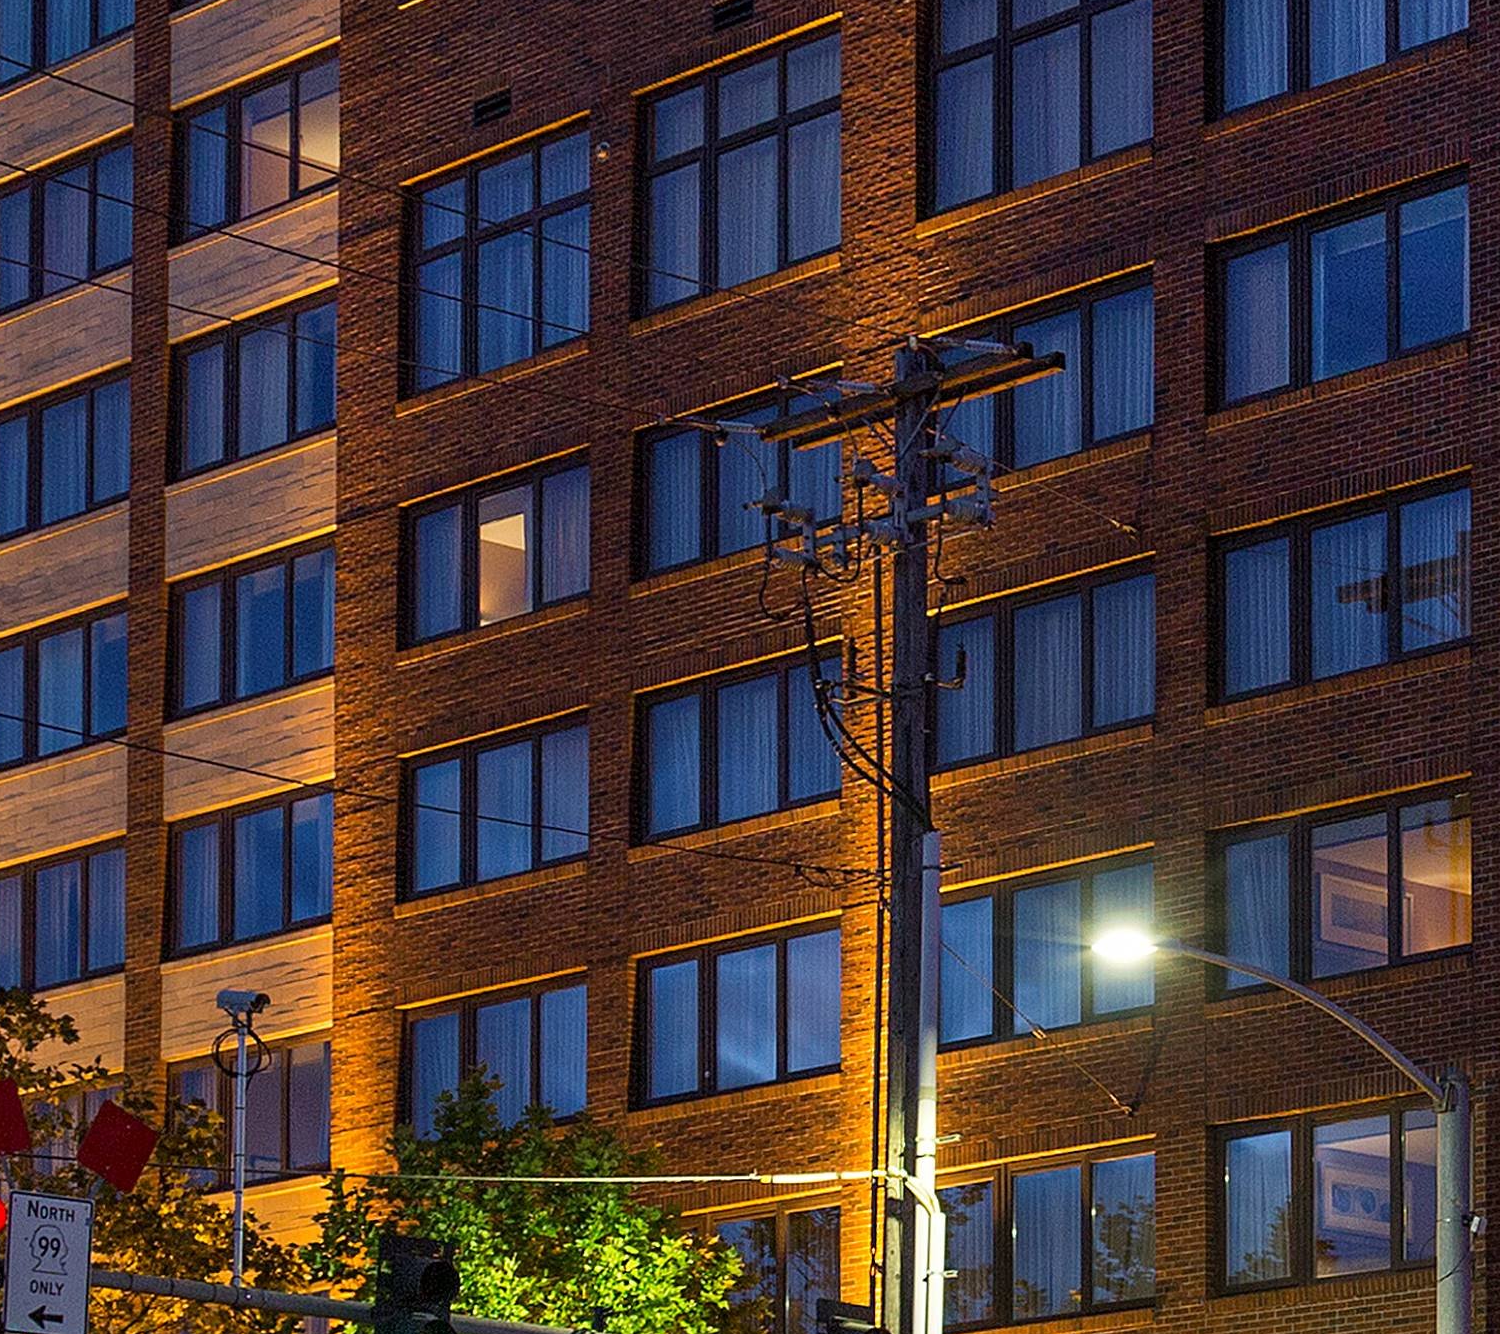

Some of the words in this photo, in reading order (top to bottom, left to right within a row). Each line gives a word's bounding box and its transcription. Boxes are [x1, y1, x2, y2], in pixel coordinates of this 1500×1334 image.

[27, 1200, 75, 1223] NORTH
[38, 1236, 61, 1259] 99
[29, 1279, 65, 1297] ONLY
